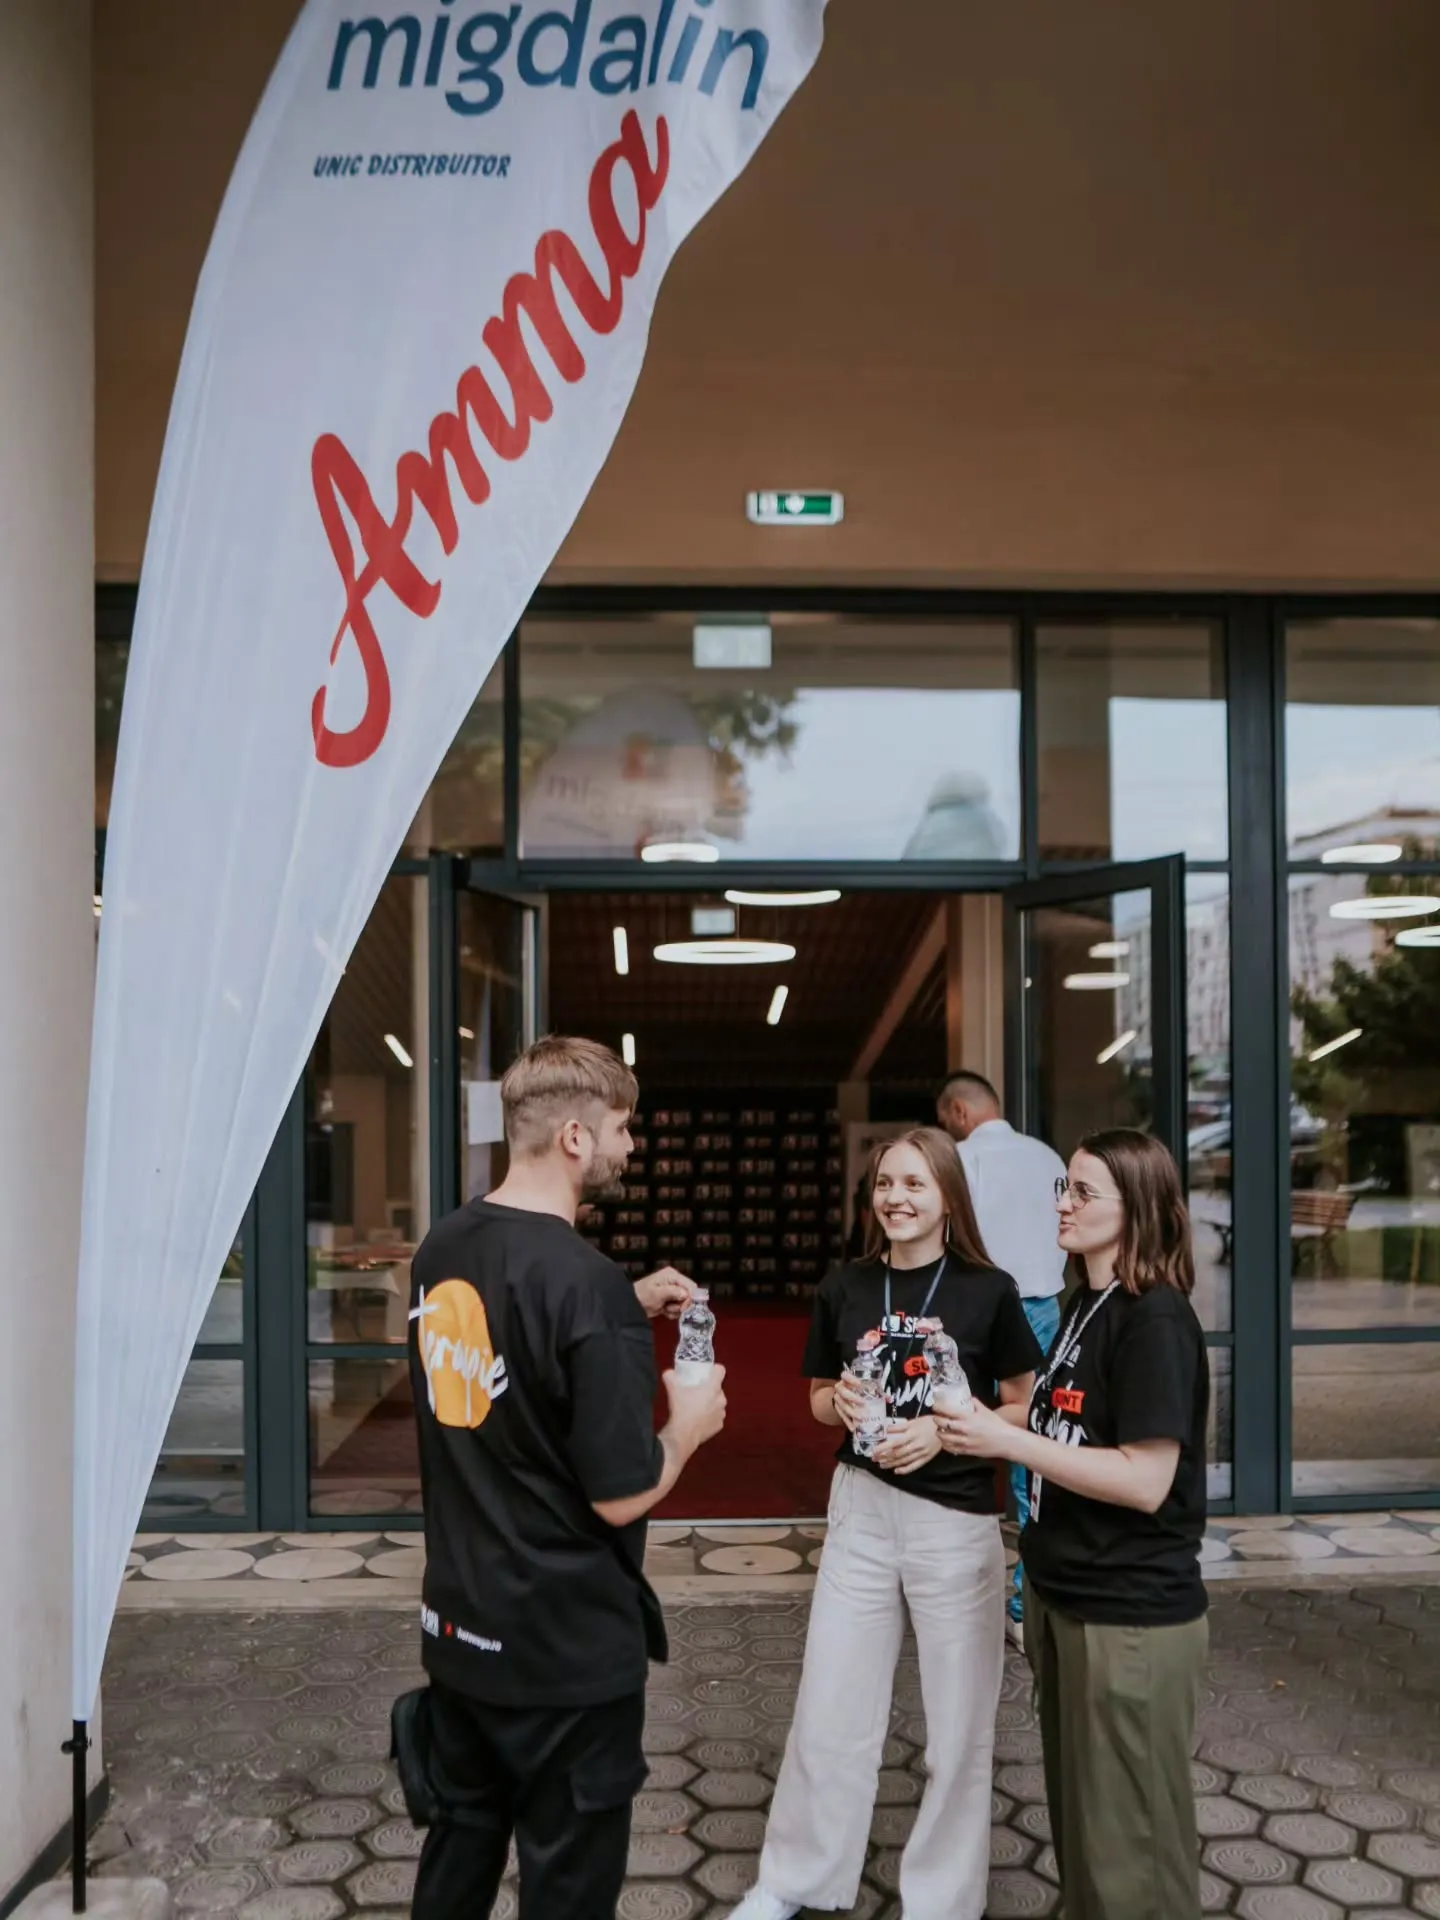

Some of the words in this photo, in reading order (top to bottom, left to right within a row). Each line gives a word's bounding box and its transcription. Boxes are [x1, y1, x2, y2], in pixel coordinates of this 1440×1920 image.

[326, 0, 769, 114] migdalin
[313, 154, 363, 178] UNIC
[367, 153, 511, 178] DISTRIBUITOR
